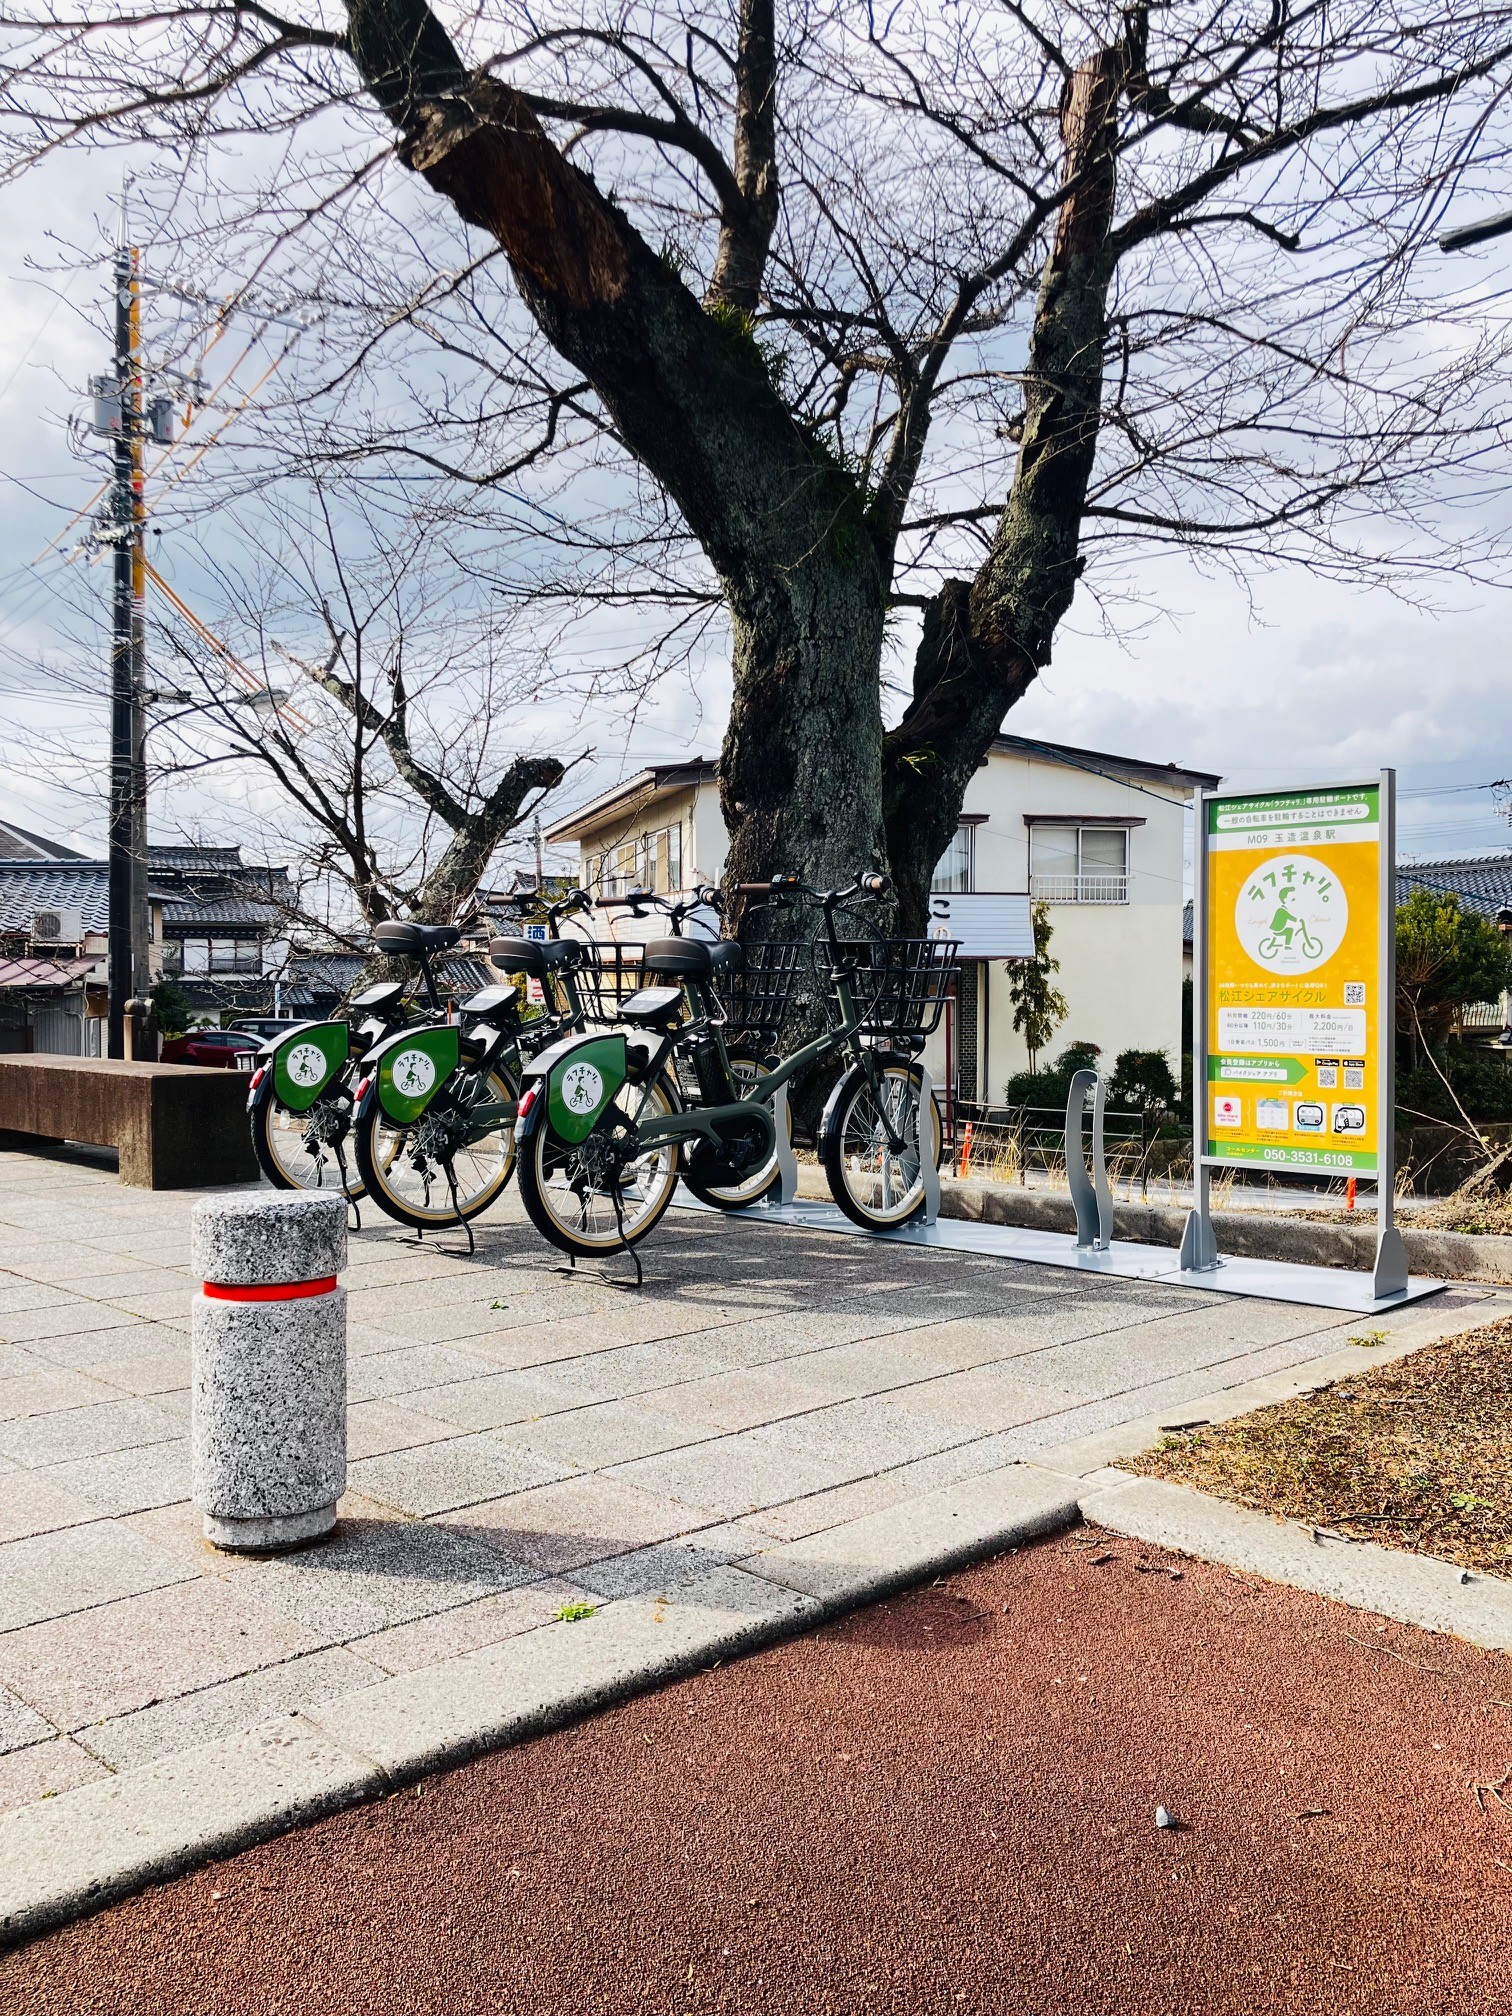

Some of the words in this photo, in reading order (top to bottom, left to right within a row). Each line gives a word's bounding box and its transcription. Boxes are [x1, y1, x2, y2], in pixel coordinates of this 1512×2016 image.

[1223, 807, 1362, 825] 一般の自転車を駐輪することはできません
[1247, 834, 1268, 844] M09
[1274, 829, 1336, 843] 玉造温泉駅
[527, 925, 546, 940] 酒
[1218, 990, 1327, 1004] 松江シェアサイクル
[1251, 1011, 1293, 1021] 220円/60分
[1253, 1021, 1293, 1031] 110円/30分
[1313, 1021, 1354, 1031] 2,200円/日
[1257, 1038, 1286, 1048] 1,500円
[1220, 1058, 1281, 1068] 会員登録はアプリから
[1263, 1148, 1354, 1167] 050-3531-6108
